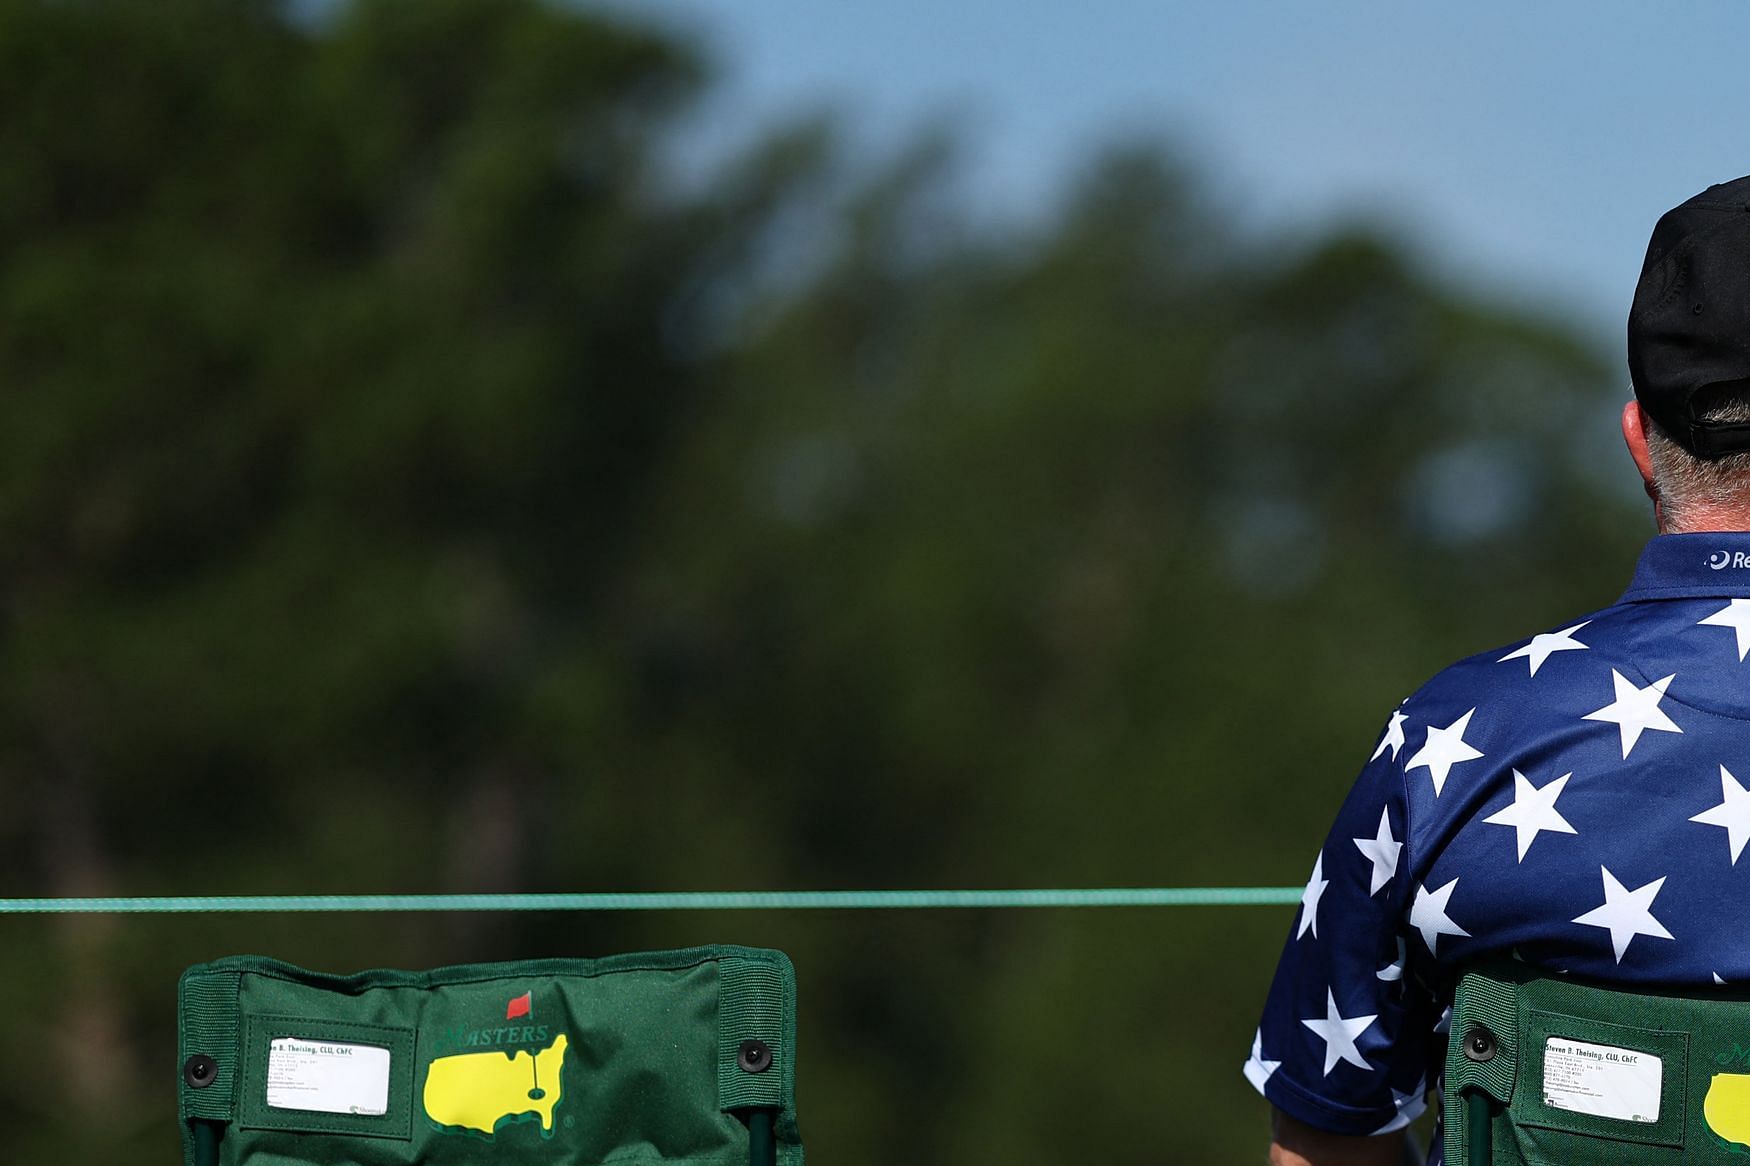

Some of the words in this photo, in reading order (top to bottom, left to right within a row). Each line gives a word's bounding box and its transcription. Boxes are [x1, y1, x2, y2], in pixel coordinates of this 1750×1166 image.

[1545, 1043, 1566, 1054] Steven
[1576, 1049, 1604, 1061] Theising,
[1605, 1052, 1620, 1062] CLU,
[1621, 1055, 1638, 1064] ChFC
